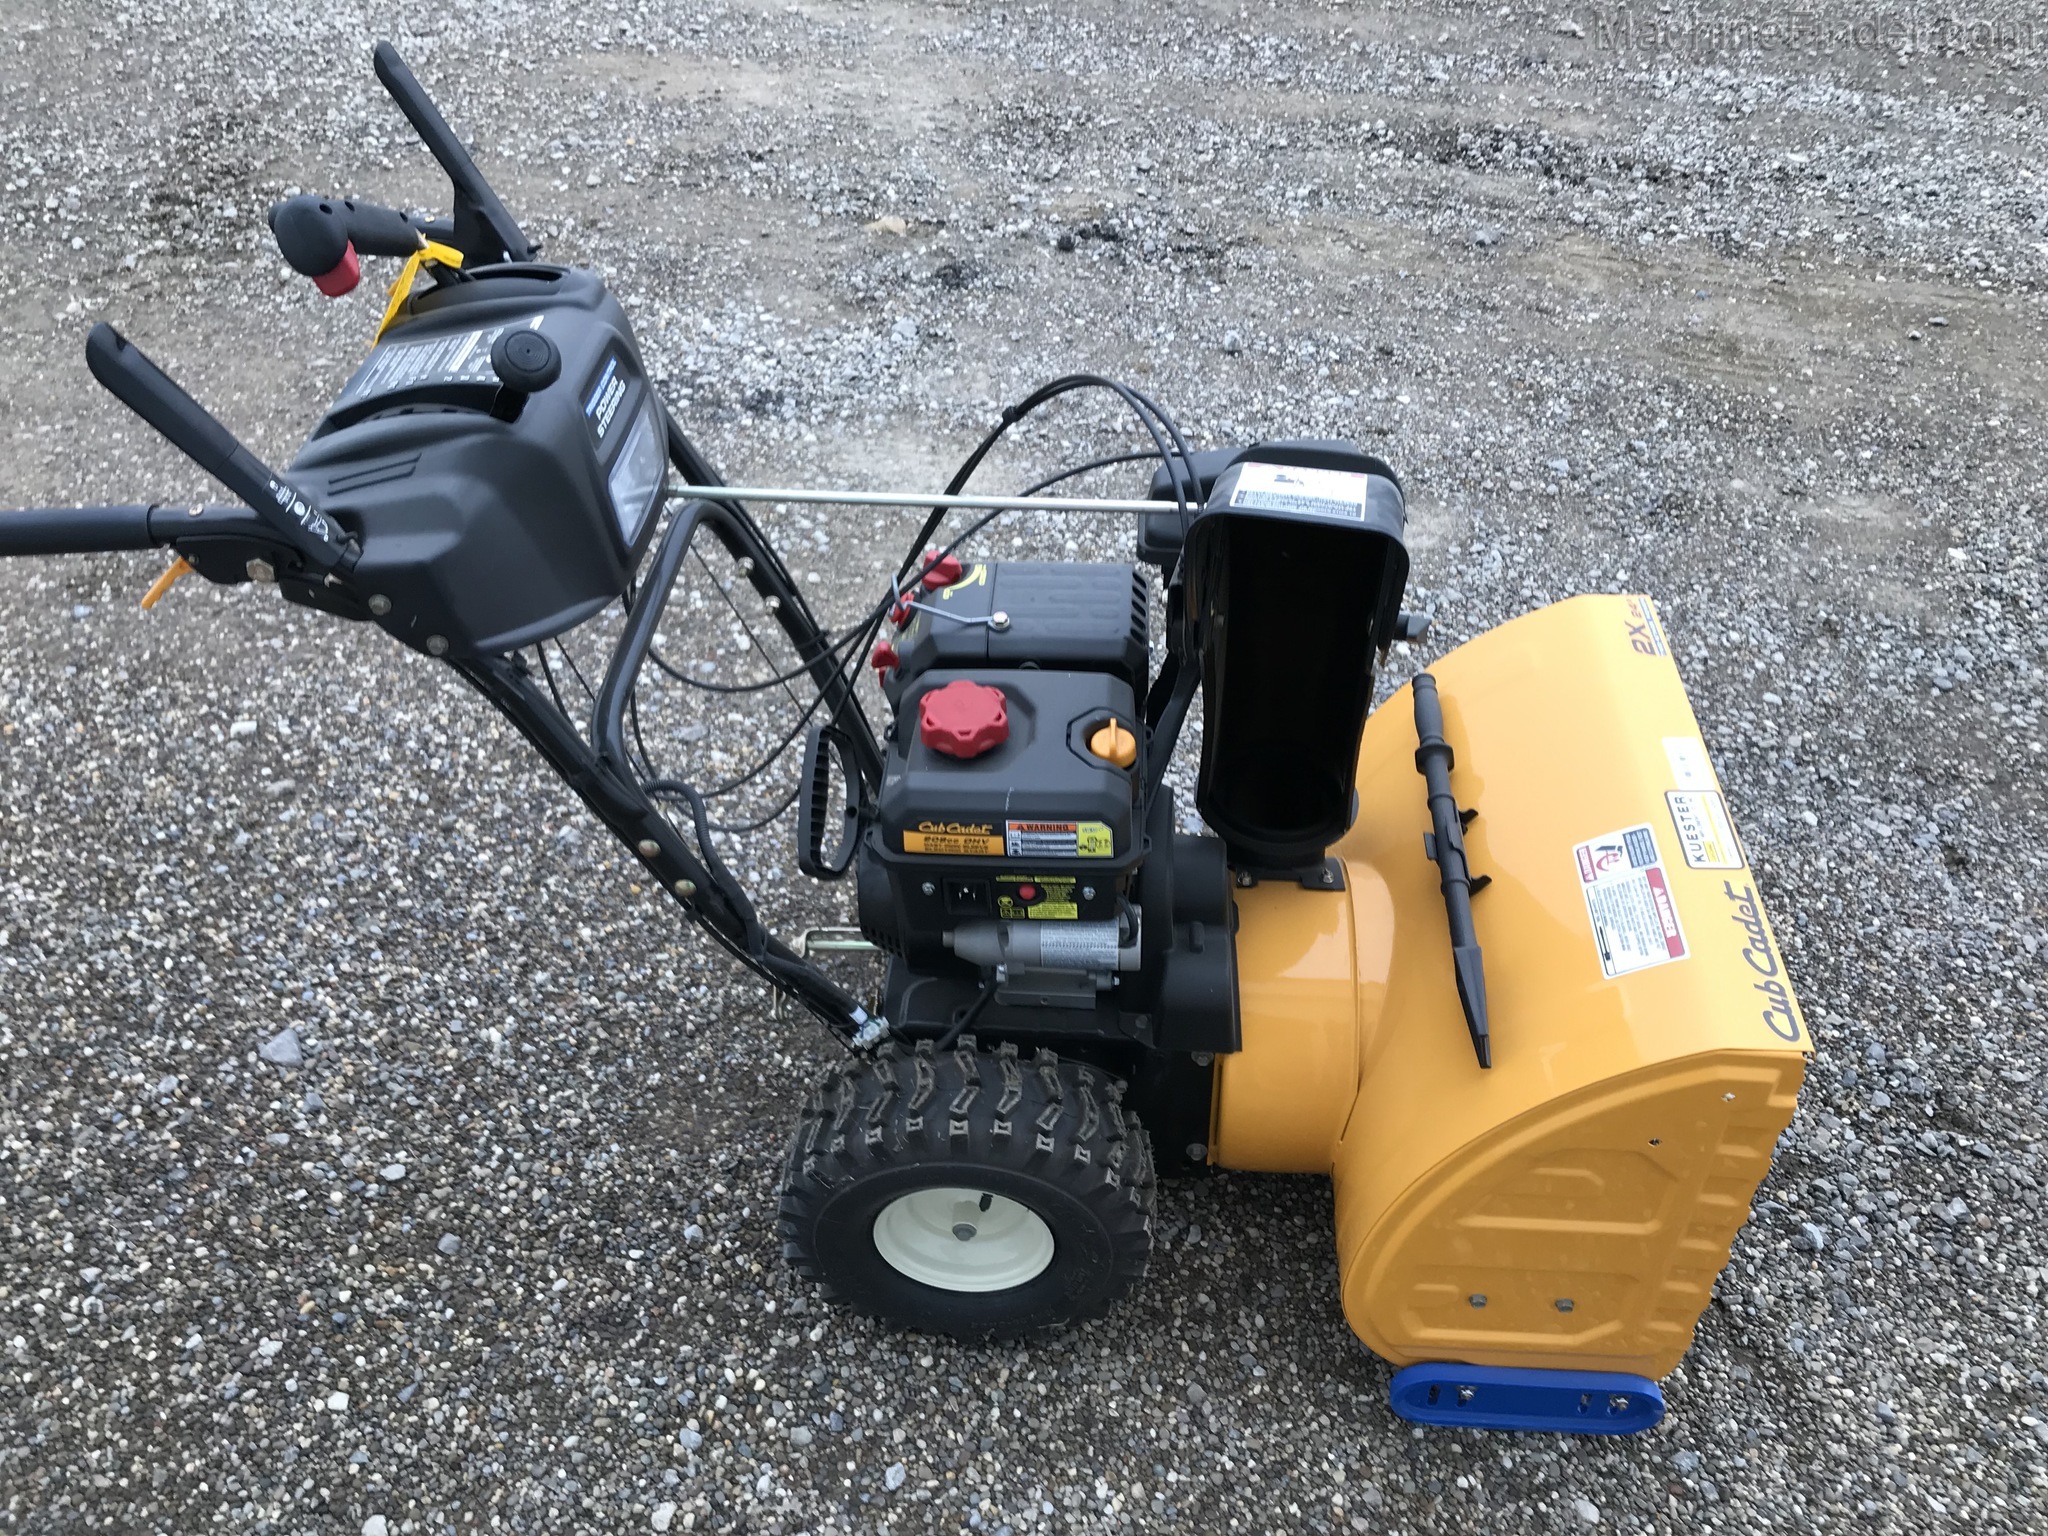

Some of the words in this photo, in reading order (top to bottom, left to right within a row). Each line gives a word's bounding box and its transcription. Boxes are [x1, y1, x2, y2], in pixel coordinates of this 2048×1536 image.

[595, 375, 619, 421] POWER
[597, 379, 626, 439] STEERING
[1624, 620, 1656, 656] 2X
[918, 821, 946, 833] Cub
[946, 822, 993, 835] Cadet
[1026, 823, 1069, 832] WARNING
[1674, 796, 1707, 863] KUESTER
[1724, 880, 1778, 977] Cadet
[1753, 980, 1800, 1042] Cub
